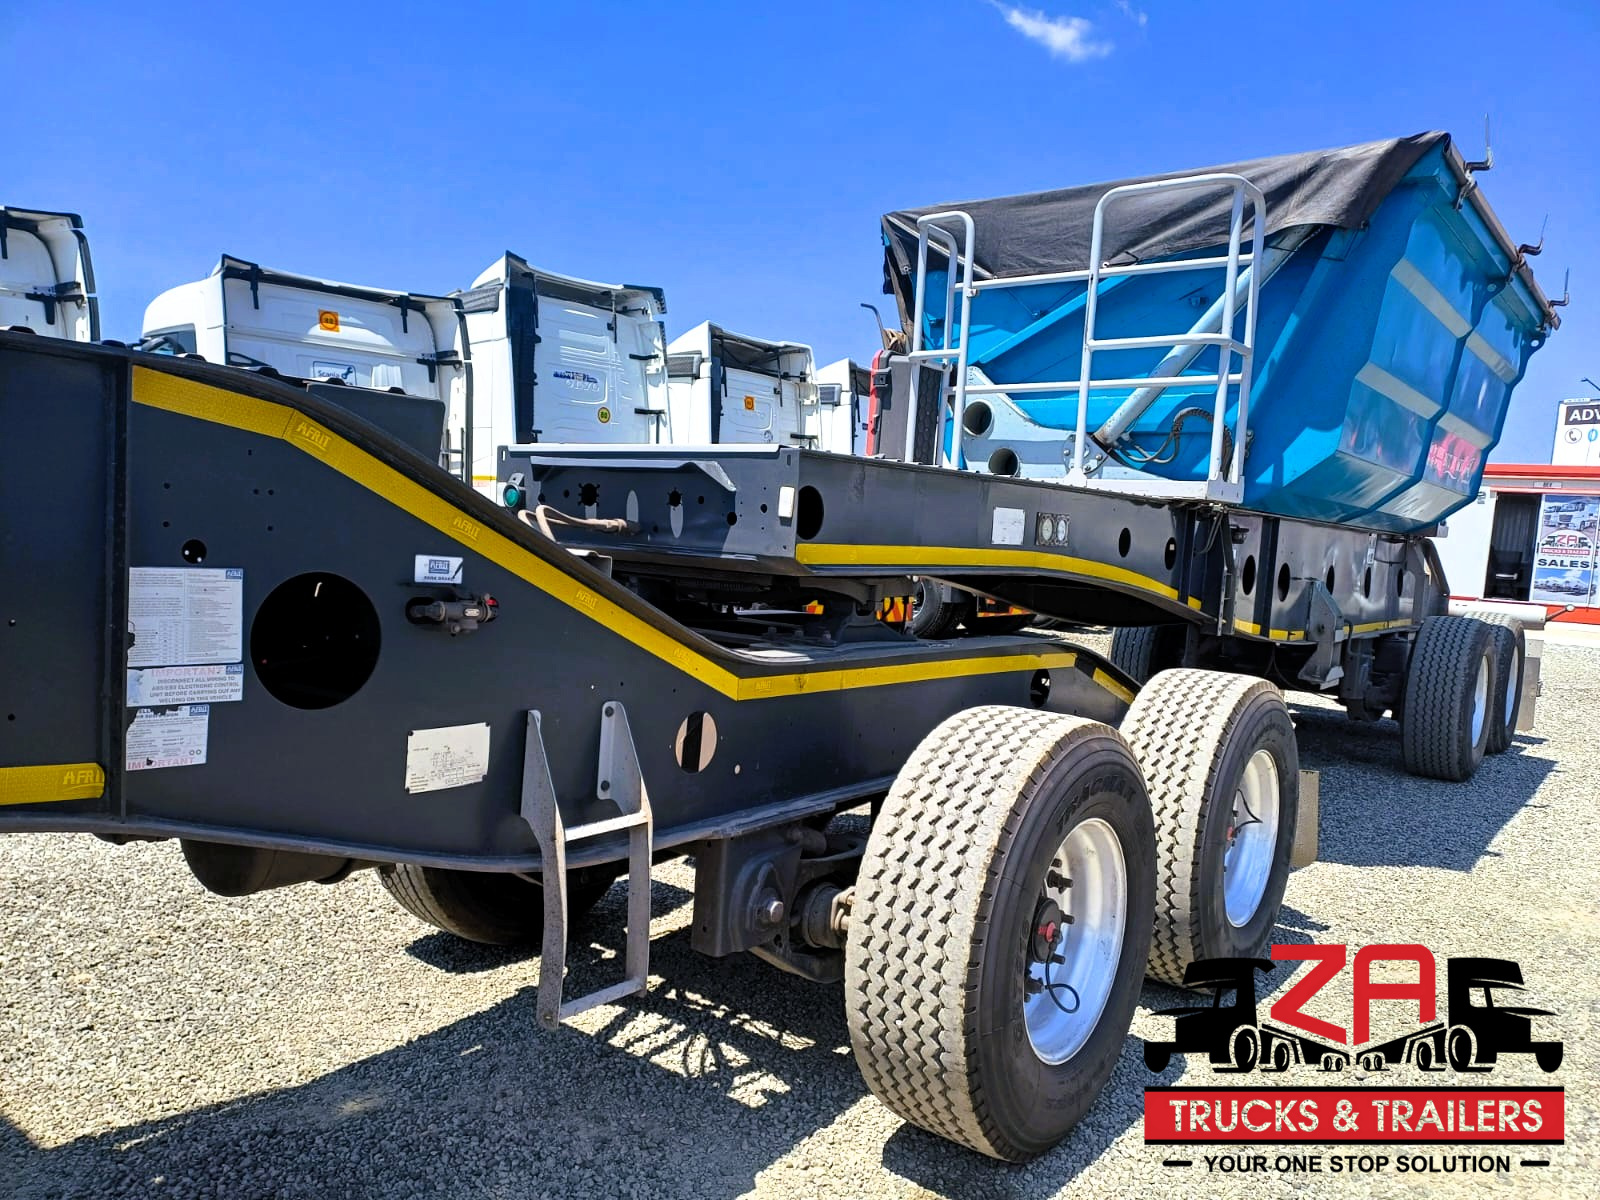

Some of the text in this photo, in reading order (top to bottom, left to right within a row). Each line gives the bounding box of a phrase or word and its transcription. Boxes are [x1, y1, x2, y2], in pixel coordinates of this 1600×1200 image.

[317, 370, 340, 378] Scania
[296, 421, 332, 448] AFRIT
[453, 516, 480, 537] AFRIT
[429, 560, 449, 569] AFRIT
[1538, 559, 1590, 569] SALES
[152, 667, 224, 677] IMPORTANT
